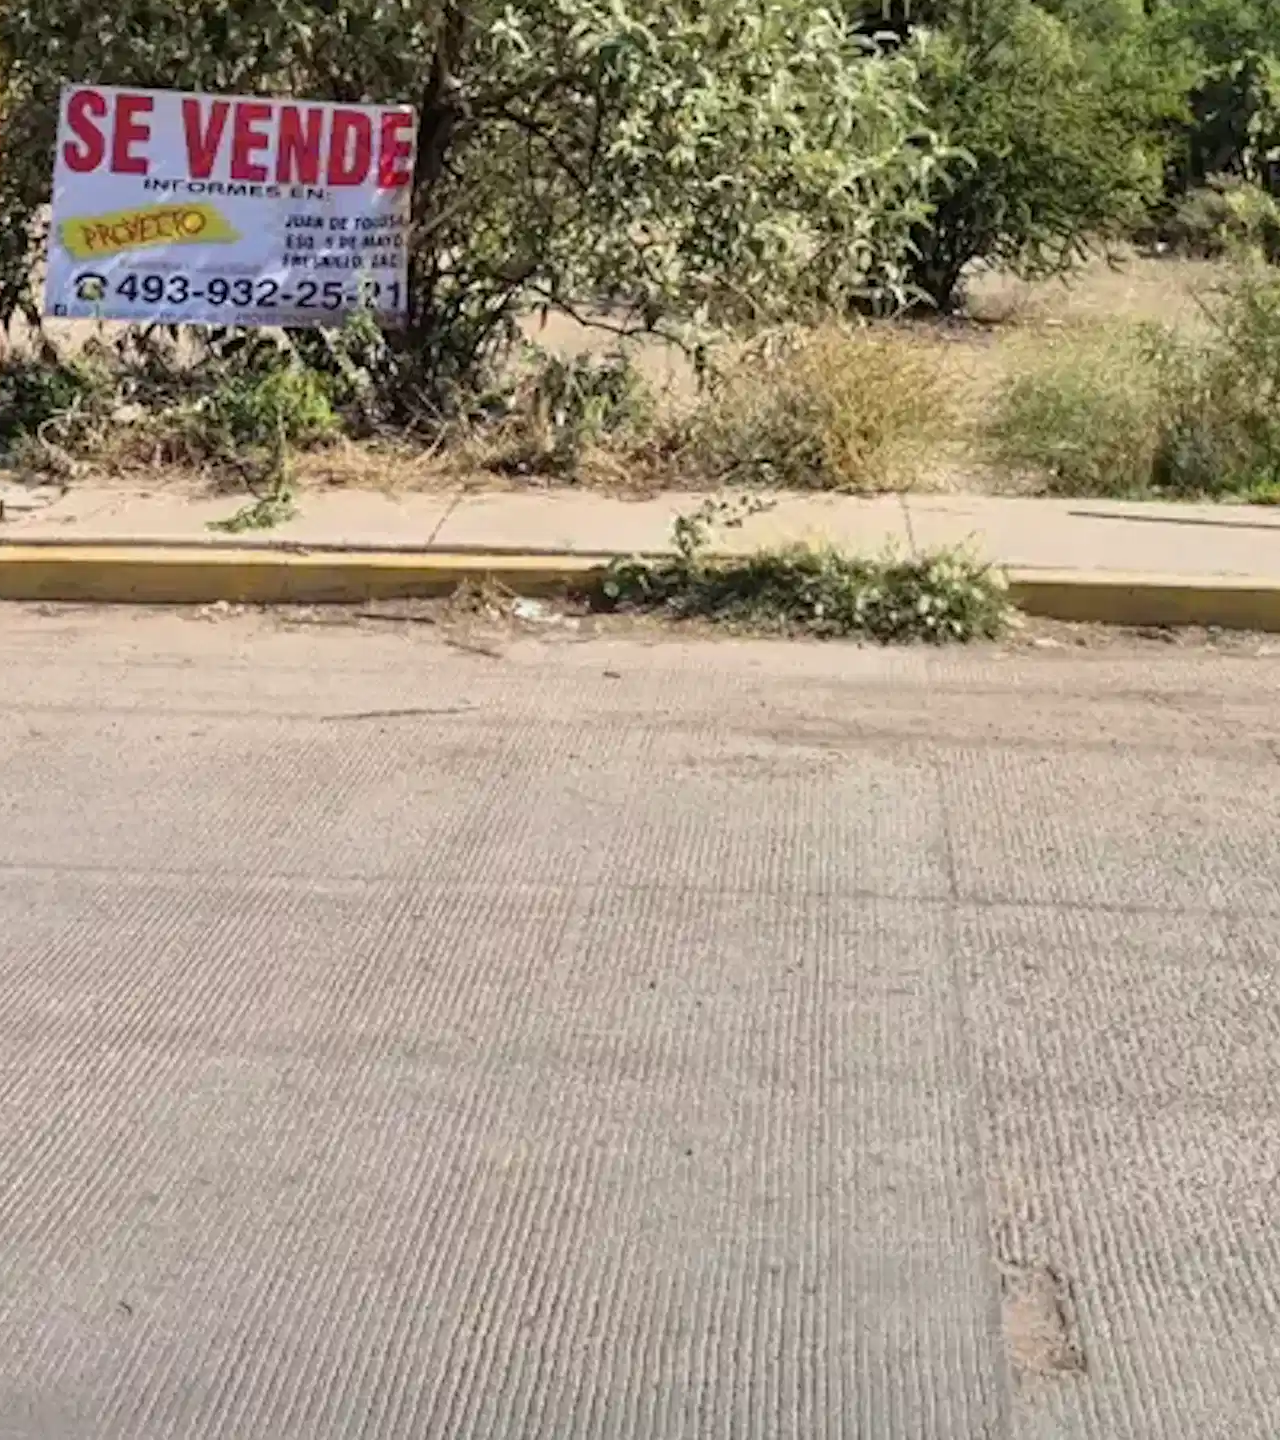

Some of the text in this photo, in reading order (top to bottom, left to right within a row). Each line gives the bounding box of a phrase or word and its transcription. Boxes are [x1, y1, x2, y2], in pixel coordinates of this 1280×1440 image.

[63, 90, 413, 188] SE VENDE
[144, 178, 281, 198] INFORMES
[80, 208, 207, 251] PROYECTO
[330, 216, 347, 230] DE
[339, 235, 356, 249] DE
